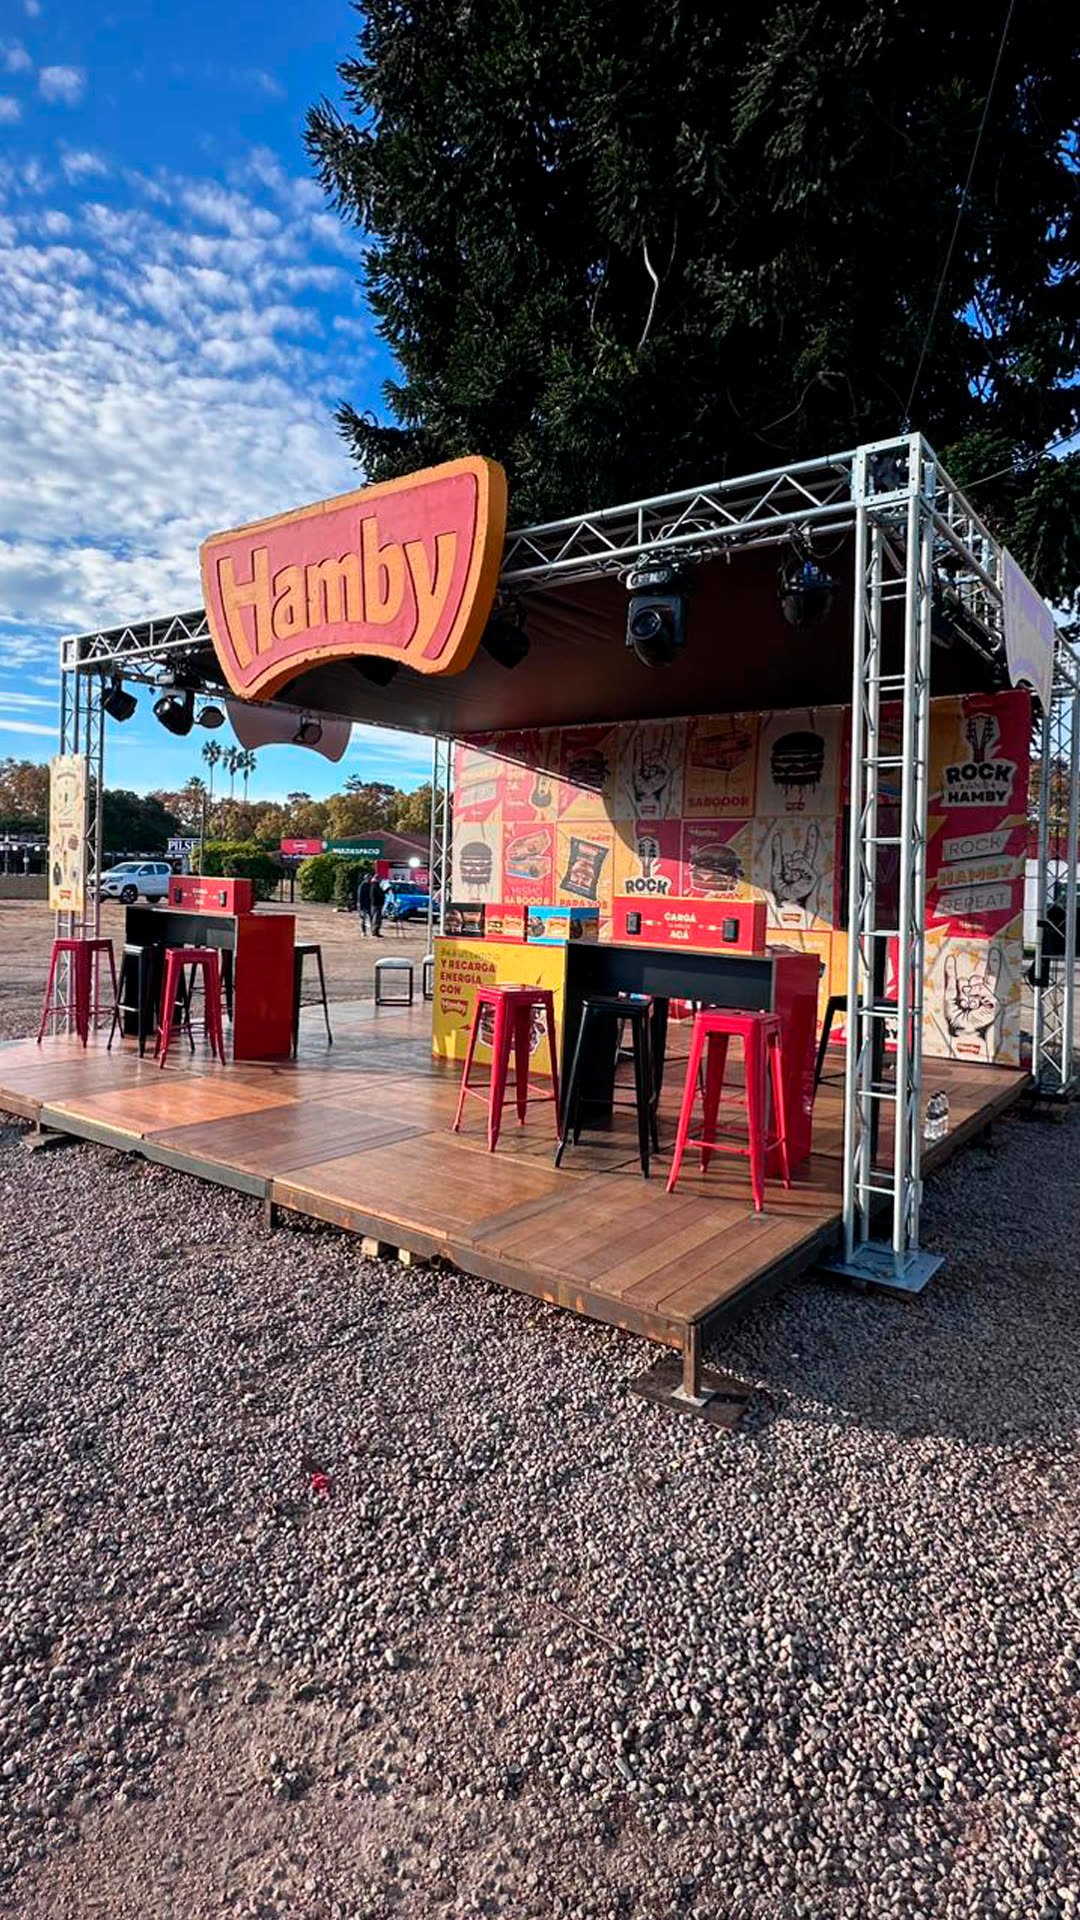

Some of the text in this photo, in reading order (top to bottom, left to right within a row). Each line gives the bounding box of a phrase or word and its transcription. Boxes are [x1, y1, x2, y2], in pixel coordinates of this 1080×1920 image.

[216, 516, 457, 669] Hamby
[946, 763, 1012, 784] ROCK
[948, 790, 1007, 803] HAMBY
[949, 834, 1001, 855] ROCK
[625, 879, 668, 895] ROCK
[941, 892, 1006, 912] REPEAT
[449, 960, 496, 973] RECARGA
[440, 984, 460, 996] CON
